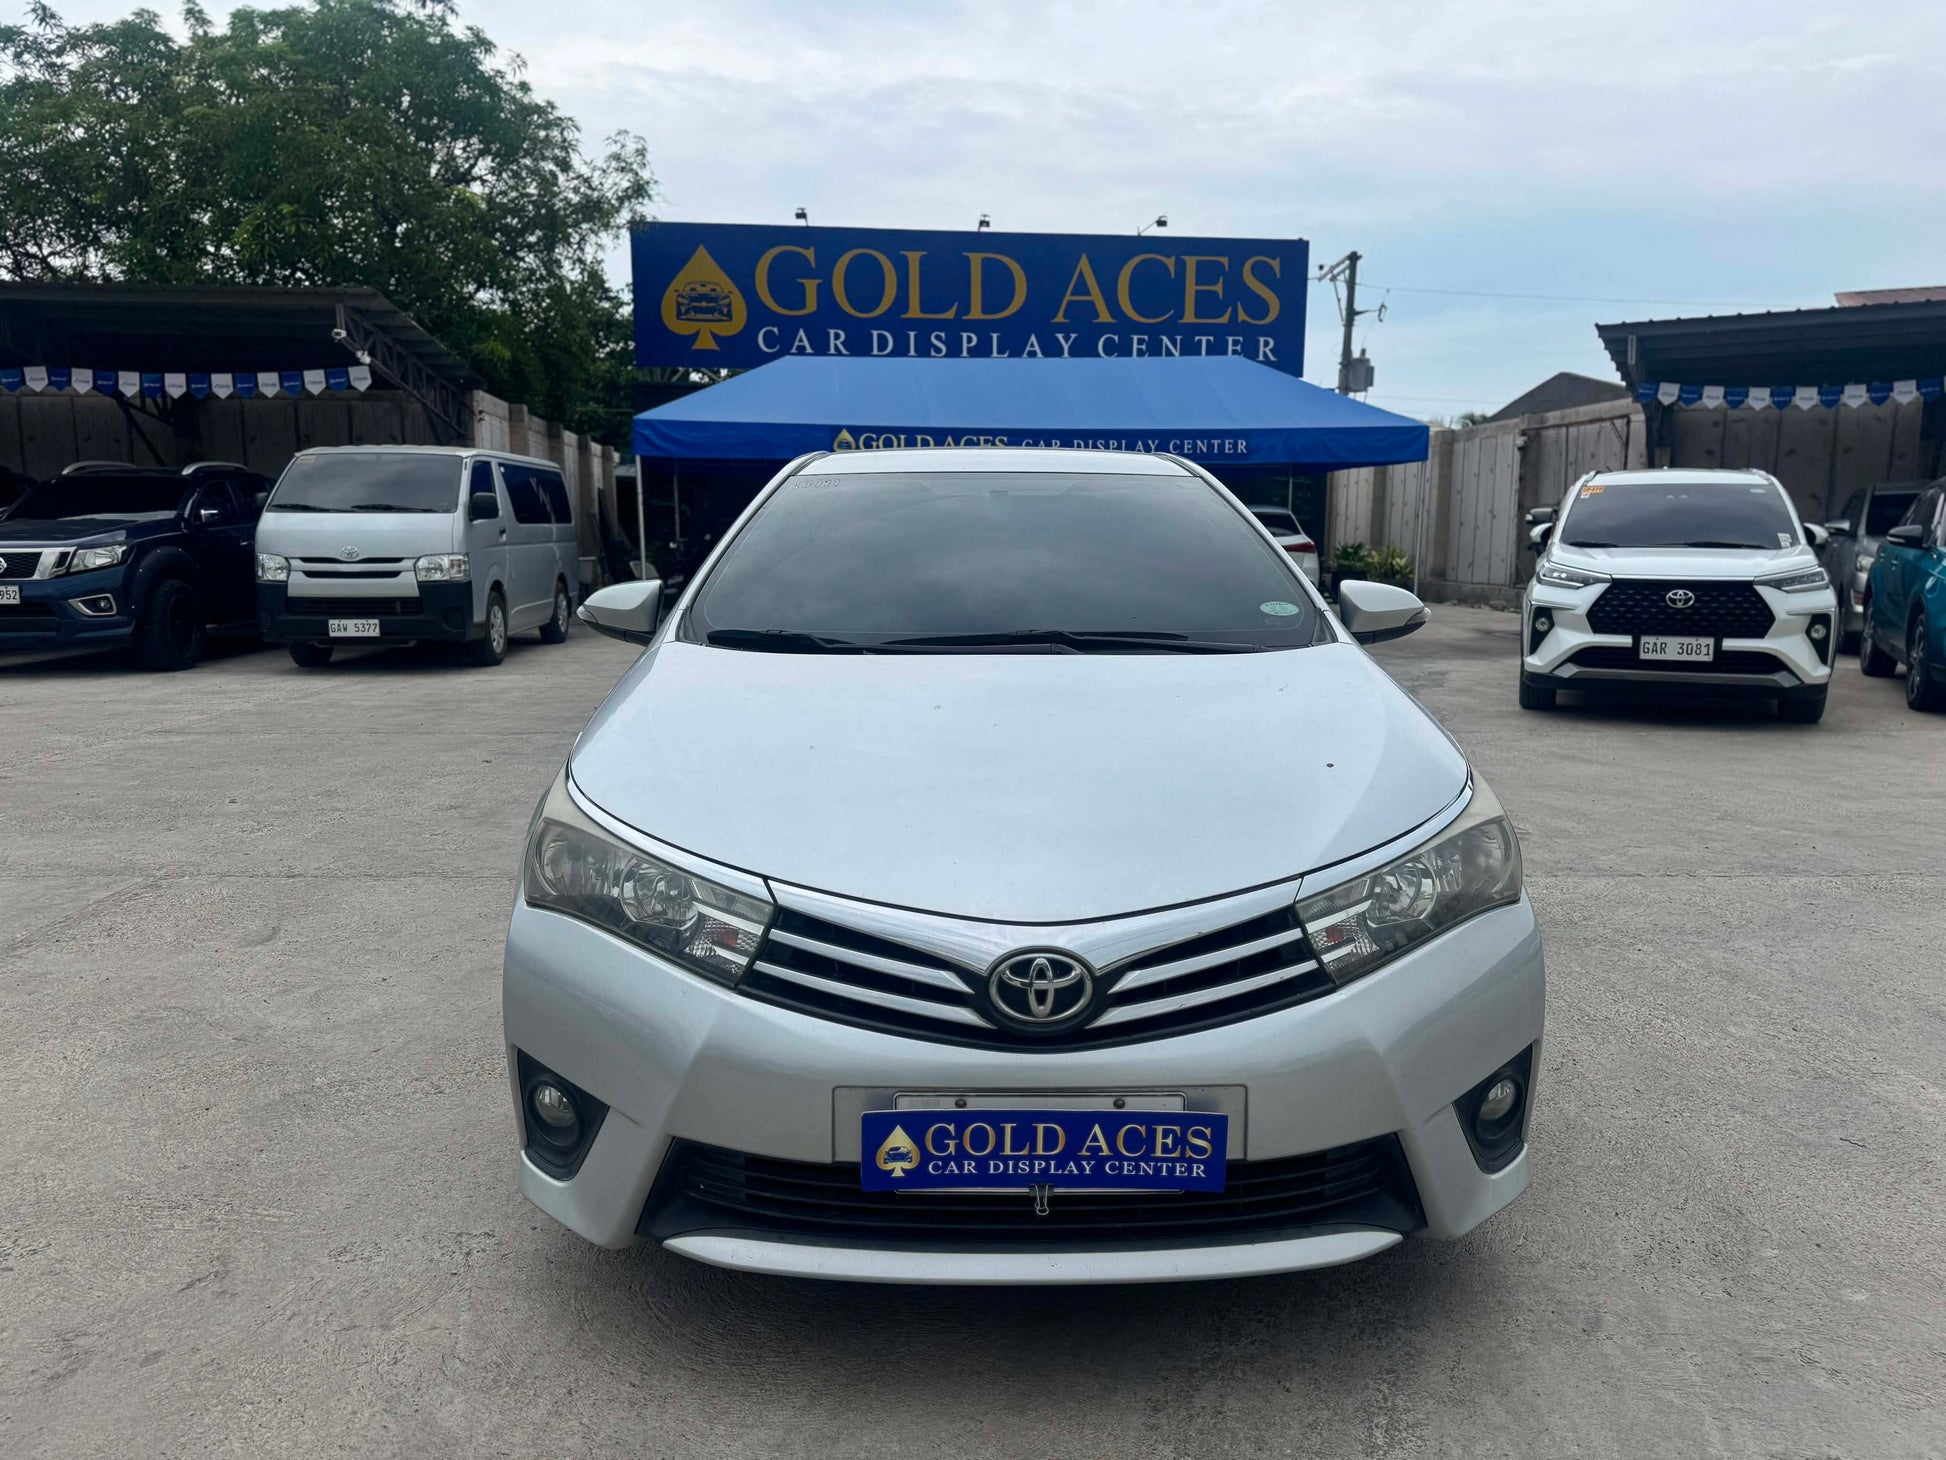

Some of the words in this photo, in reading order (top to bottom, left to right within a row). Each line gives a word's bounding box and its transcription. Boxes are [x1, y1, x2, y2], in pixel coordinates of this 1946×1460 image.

[755, 245, 1028, 320] GOLD
[1051, 252, 1281, 326] ACES
[757, 326, 850, 355] CAR
[870, 329, 1078, 358] DISPLAY
[1097, 333, 1277, 362] CENTER
[858, 432, 935, 450] GOLD
[943, 435, 1008, 449] ACES
[1073, 439, 1159, 454] DISPLAY
[1169, 439, 1248, 454] CENTER
[330, 622, 348, 633] GAW
[354, 622, 378, 633] 5377
[1642, 641, 1668, 655] GAR
[1676, 642, 1711, 656] 3081
[924, 1122, 1066, 1156] GOLD
[1077, 1123, 1213, 1160] ACES
[928, 1160, 977, 1175] CAR
[988, 1160, 1096, 1176] DISPLAY
[1105, 1161, 1207, 1178] CENTER
